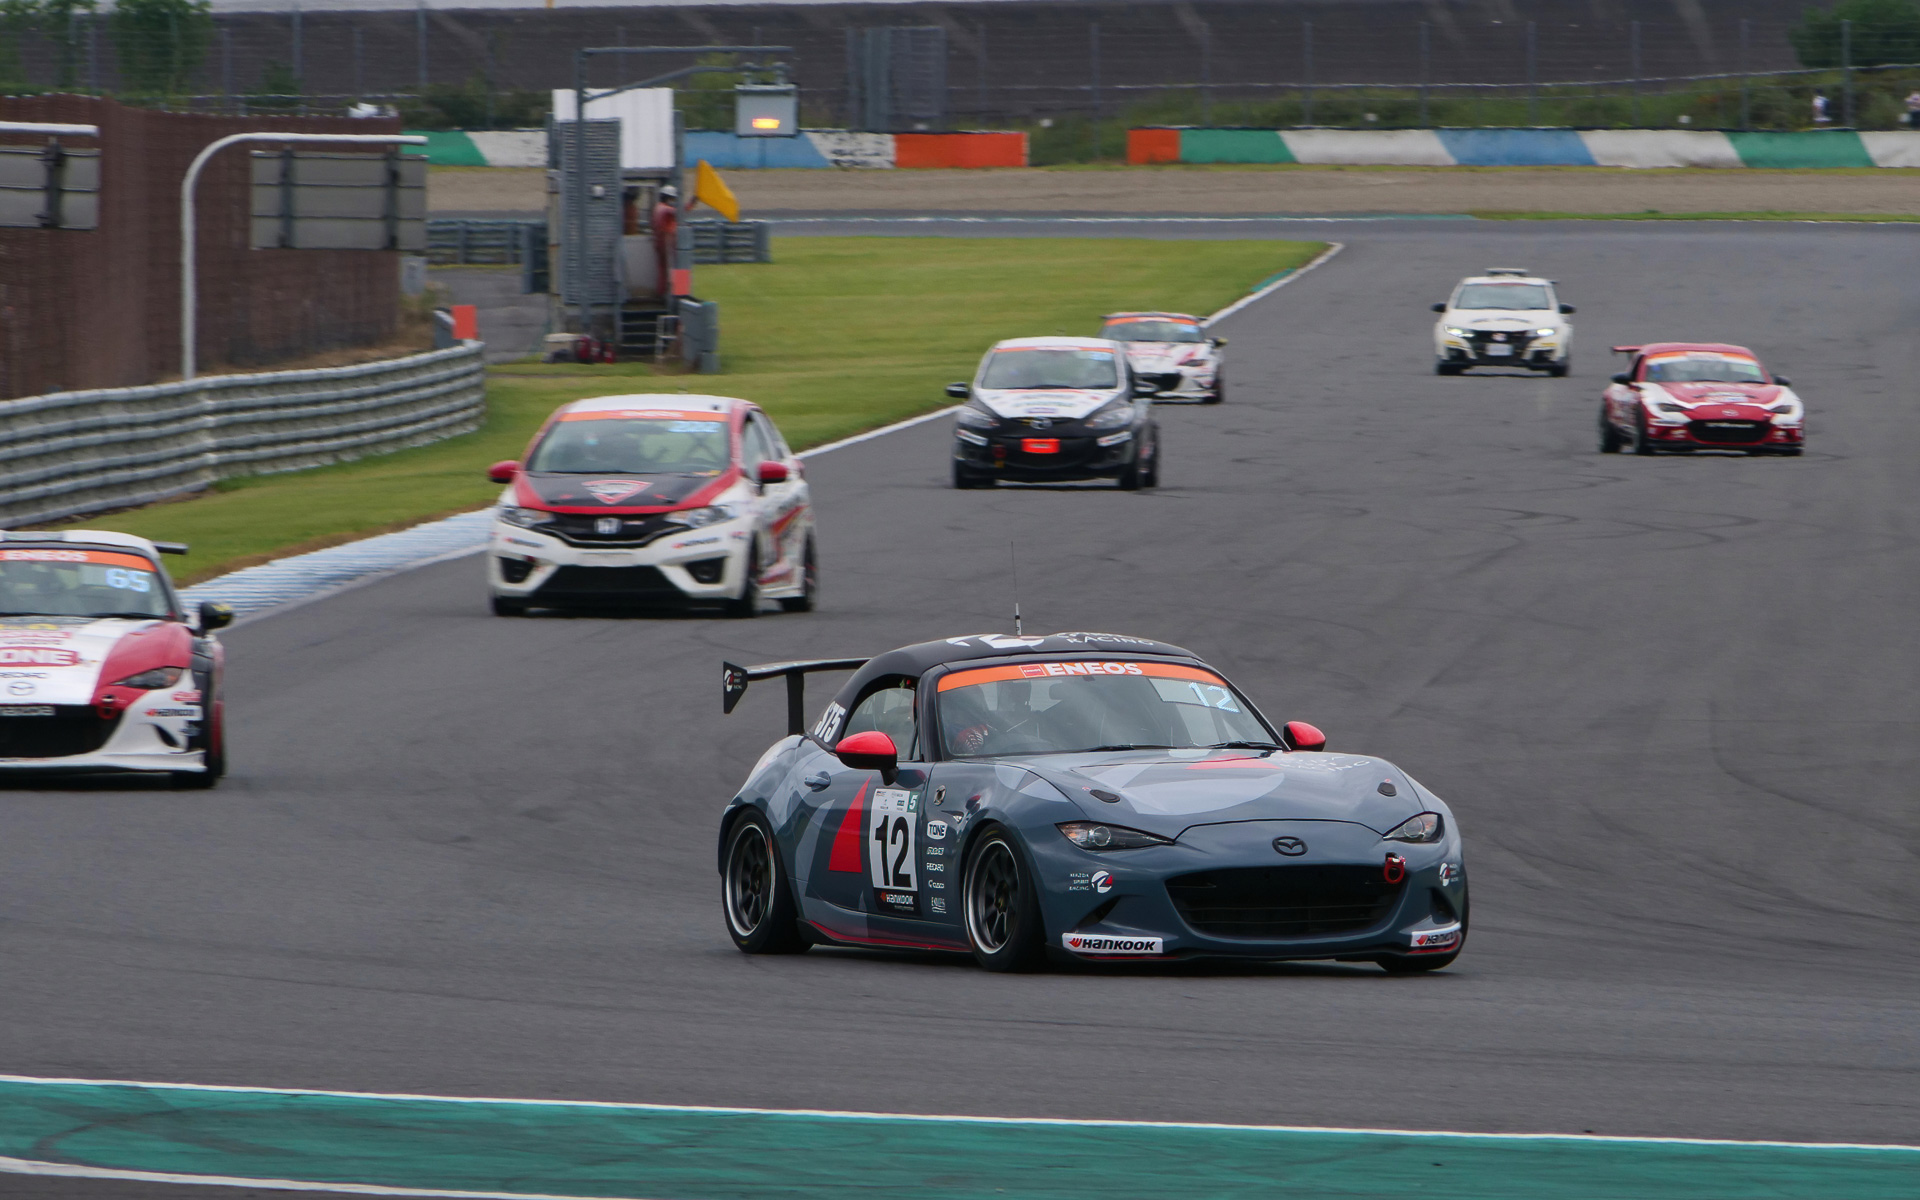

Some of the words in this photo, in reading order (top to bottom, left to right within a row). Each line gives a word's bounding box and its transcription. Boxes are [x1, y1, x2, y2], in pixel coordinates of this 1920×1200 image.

[6, 551, 88, 562] ENEOS
[106, 568, 150, 592] 65
[1044, 662, 1142, 675] ENEOS
[1189, 682, 1240, 713] 12
[814, 700, 847, 743] ST5
[928, 823, 945, 837] TONE
[875, 815, 912, 888] 12
